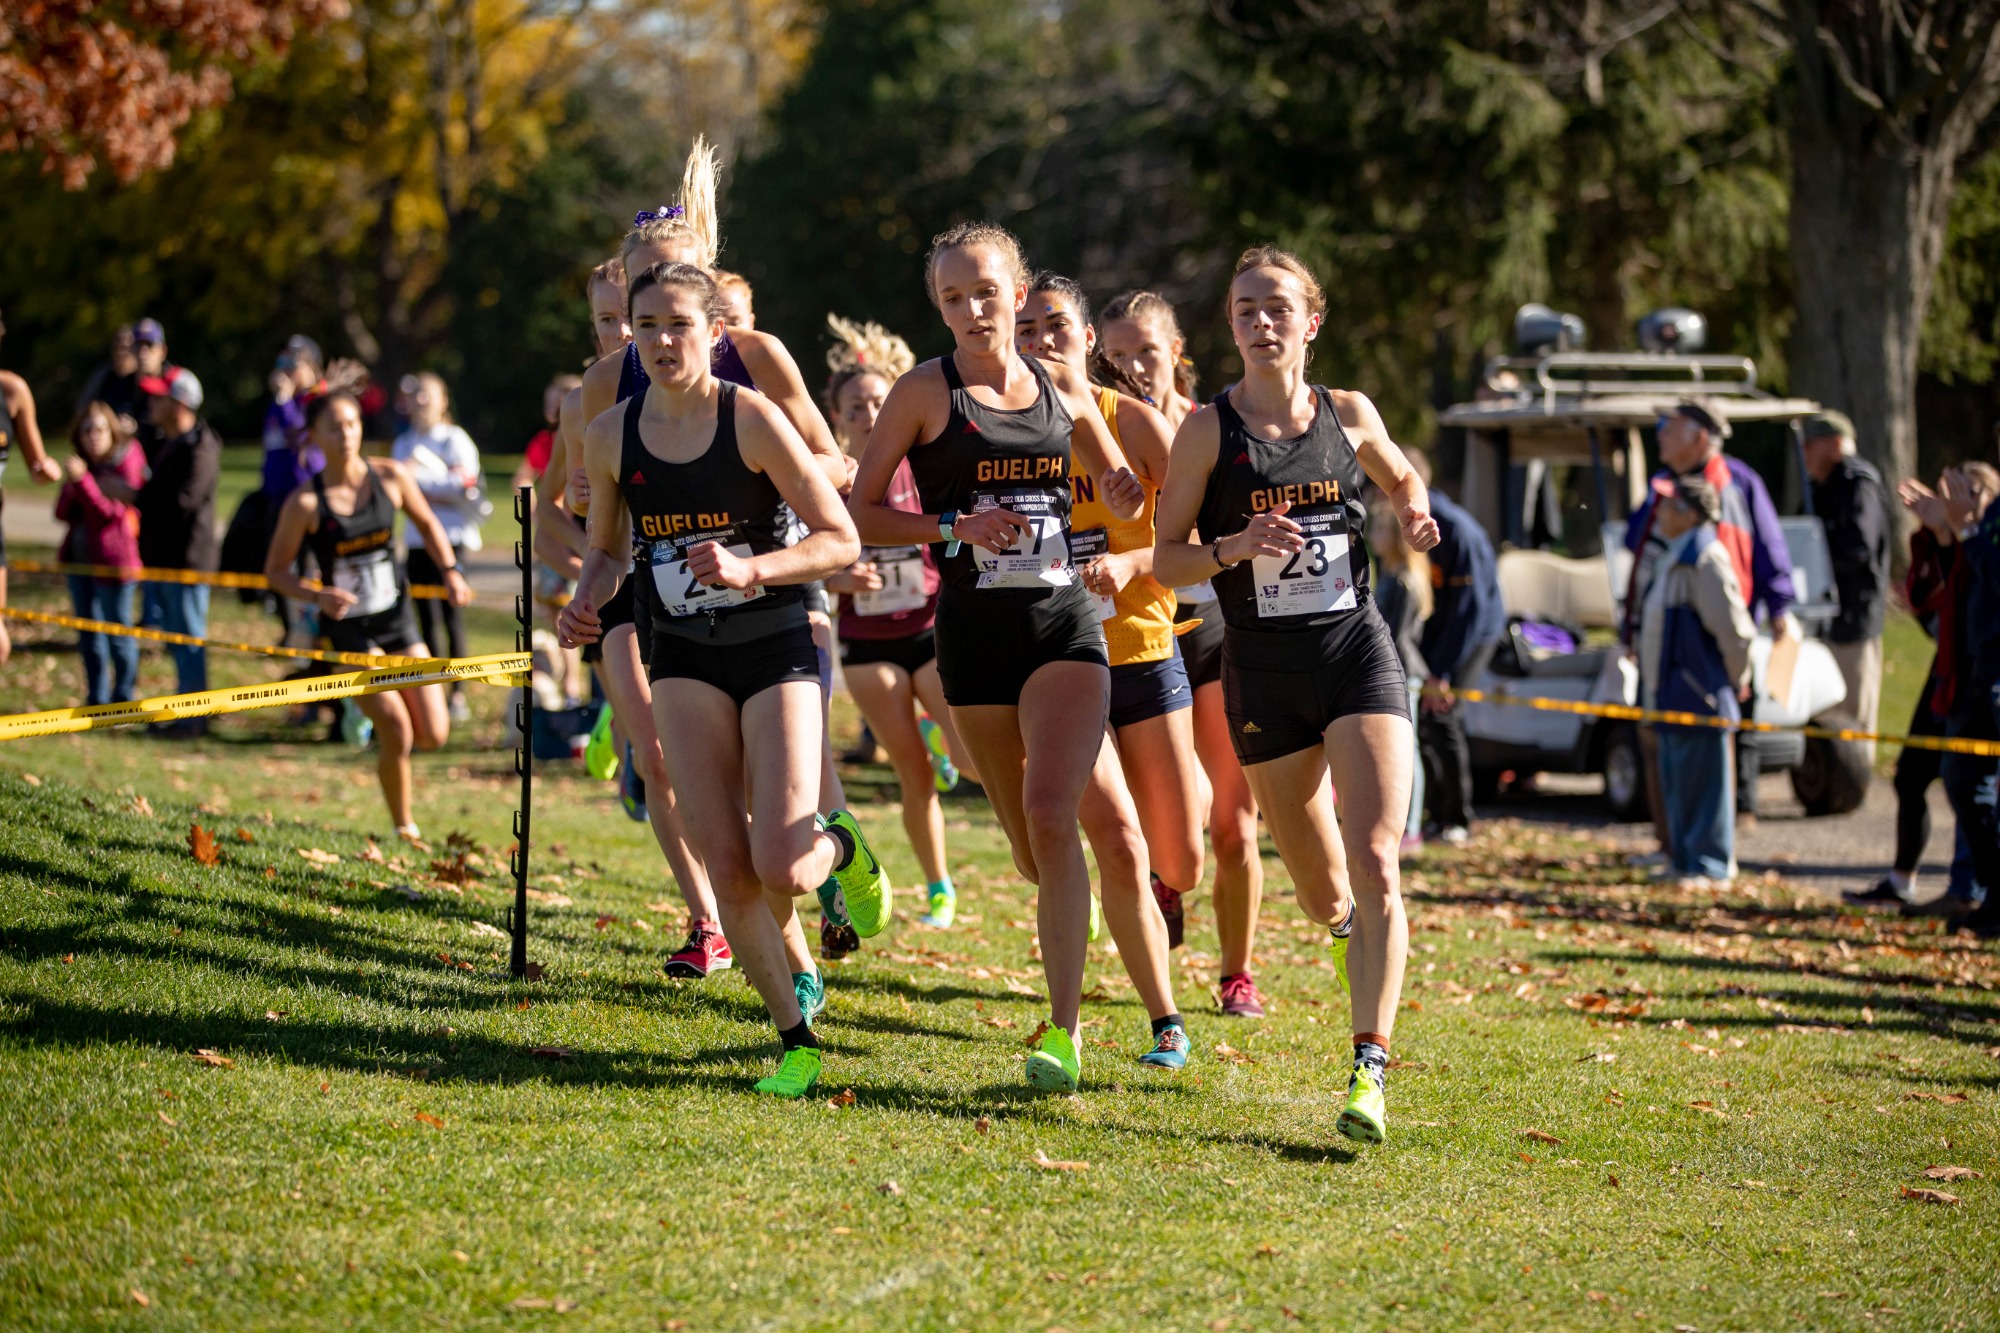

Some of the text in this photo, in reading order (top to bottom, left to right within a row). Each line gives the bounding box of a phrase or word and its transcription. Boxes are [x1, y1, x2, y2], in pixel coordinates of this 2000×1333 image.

[977, 456, 1063, 482] GUELPH
[1000, 496, 1014, 504] 2022
[1025, 495, 1040, 503] CROSS
[1250, 480, 1339, 512] GUELPH
[1303, 515, 1319, 523] CROSS
[1320, 513, 1341, 522] COUNTRY
[1084, 534, 1105, 544] COUNTRY
[1279, 538, 1329, 580] 23
